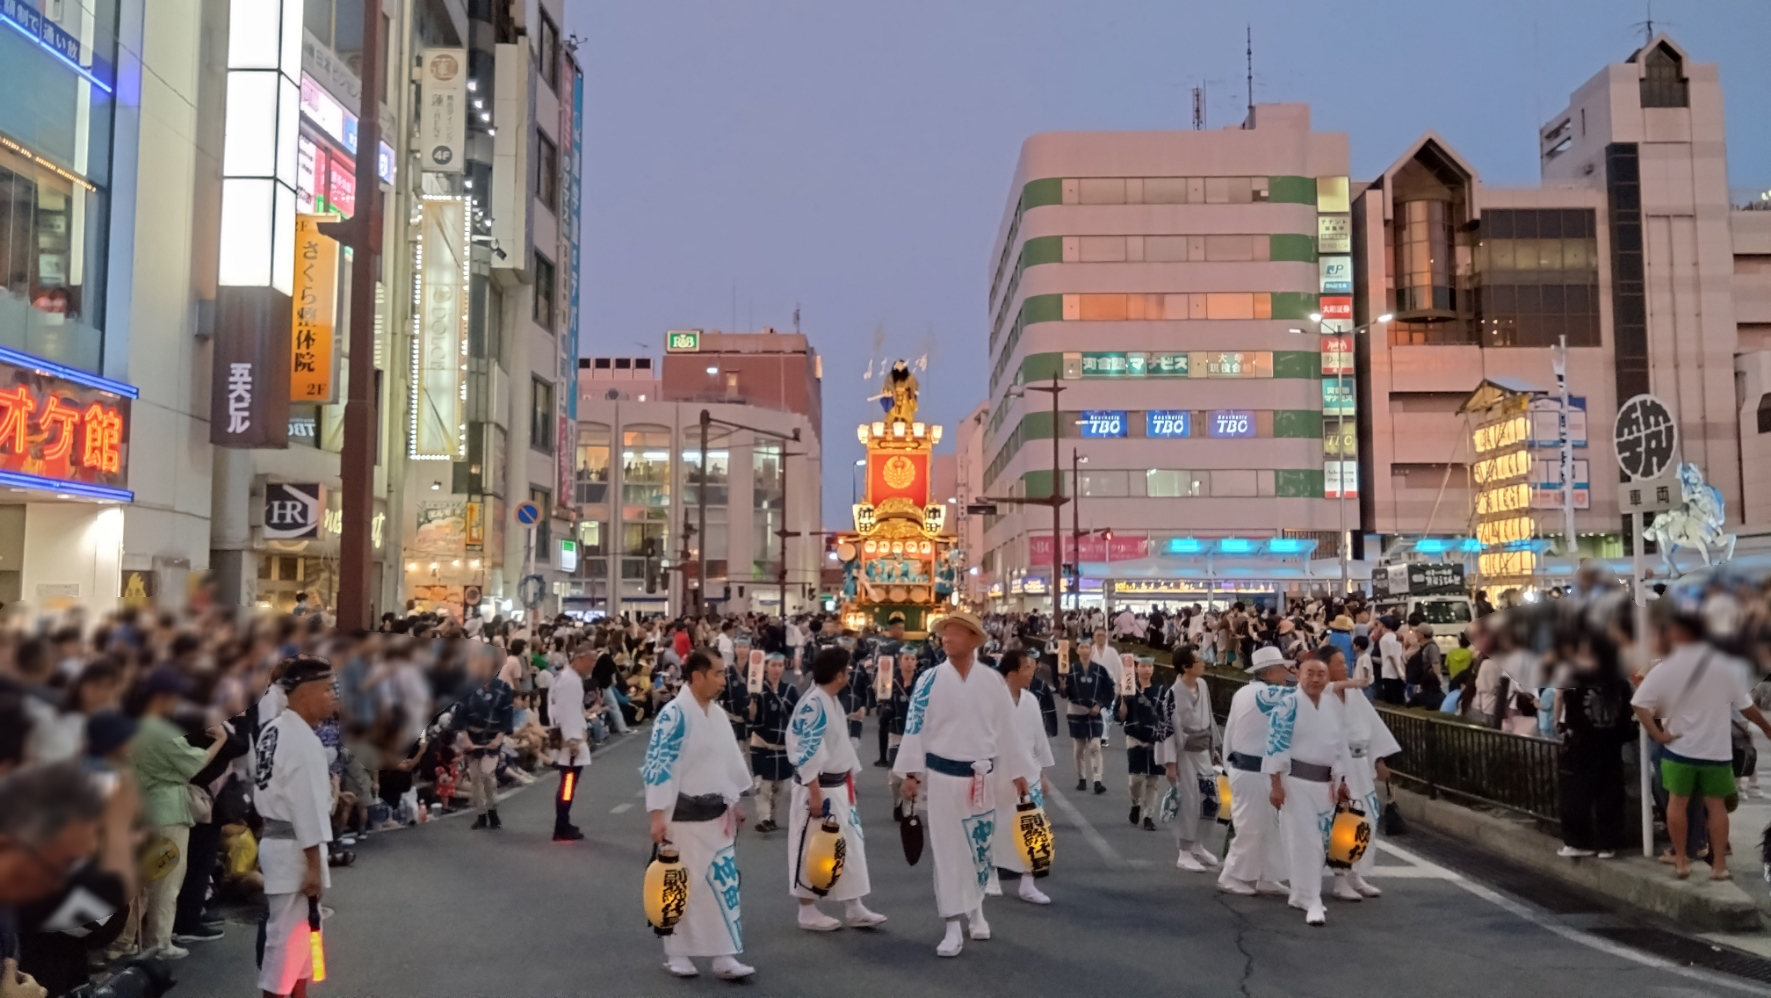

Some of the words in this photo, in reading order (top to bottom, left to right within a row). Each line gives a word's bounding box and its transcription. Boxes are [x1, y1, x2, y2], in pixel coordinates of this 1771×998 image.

[434, 151, 450, 160] 4F
[294, 240, 319, 373] さくら整体院
[306, 383, 328, 396] 2F
[1629, 486, 1670, 506] 車両
[270, 500, 305, 524] HR
